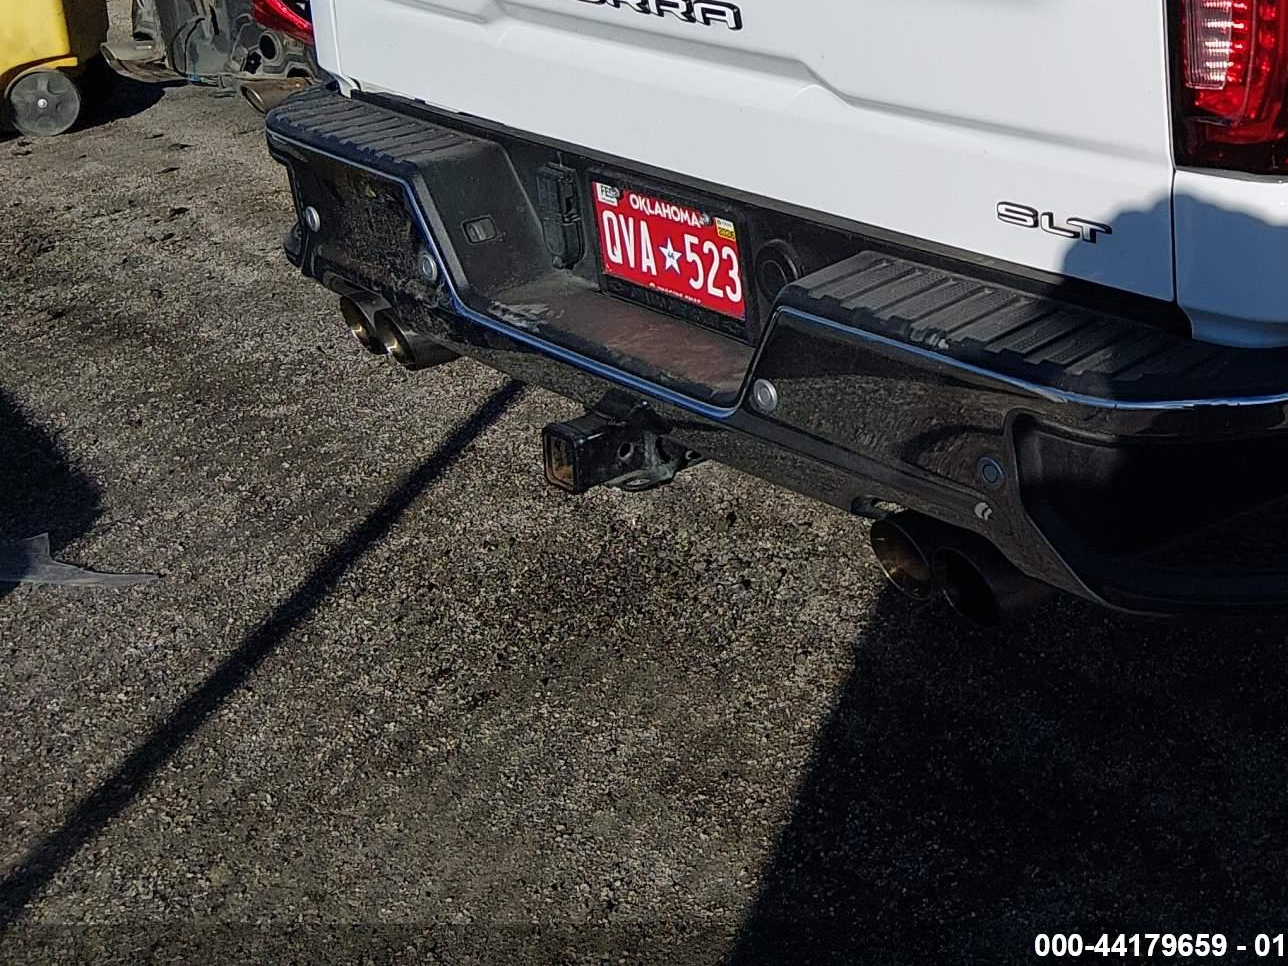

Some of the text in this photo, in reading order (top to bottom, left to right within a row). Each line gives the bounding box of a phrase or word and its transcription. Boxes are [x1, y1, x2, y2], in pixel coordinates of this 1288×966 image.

[629, 193, 702, 228] OKLAHOMA
[997, 201, 1113, 244] SLT
[602, 209, 743, 303] QVA 523
